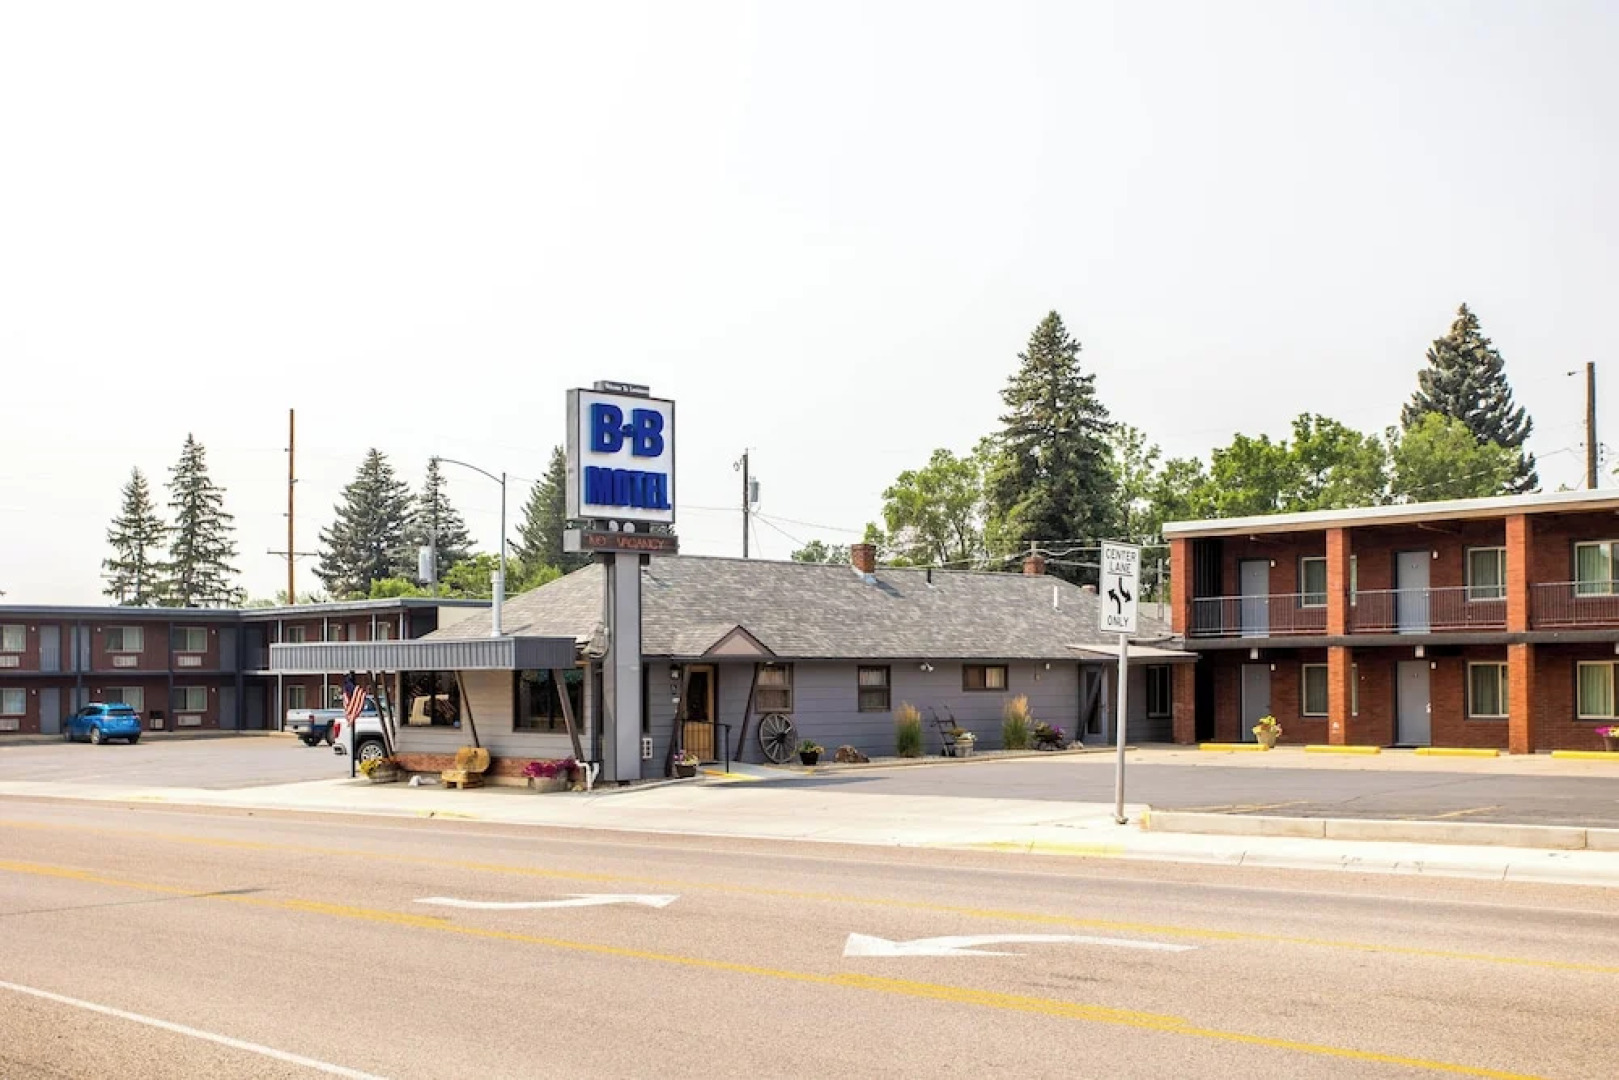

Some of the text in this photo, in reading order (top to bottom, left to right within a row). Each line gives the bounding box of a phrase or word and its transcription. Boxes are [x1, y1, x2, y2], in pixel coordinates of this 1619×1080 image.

[584, 466, 671, 510] MOTEL
[588, 534, 664, 550] NO VACANCY
[1106, 548, 1136, 562] CENTER
[1109, 561, 1131, 573] LANE
[1107, 614, 1129, 627] ONLY
